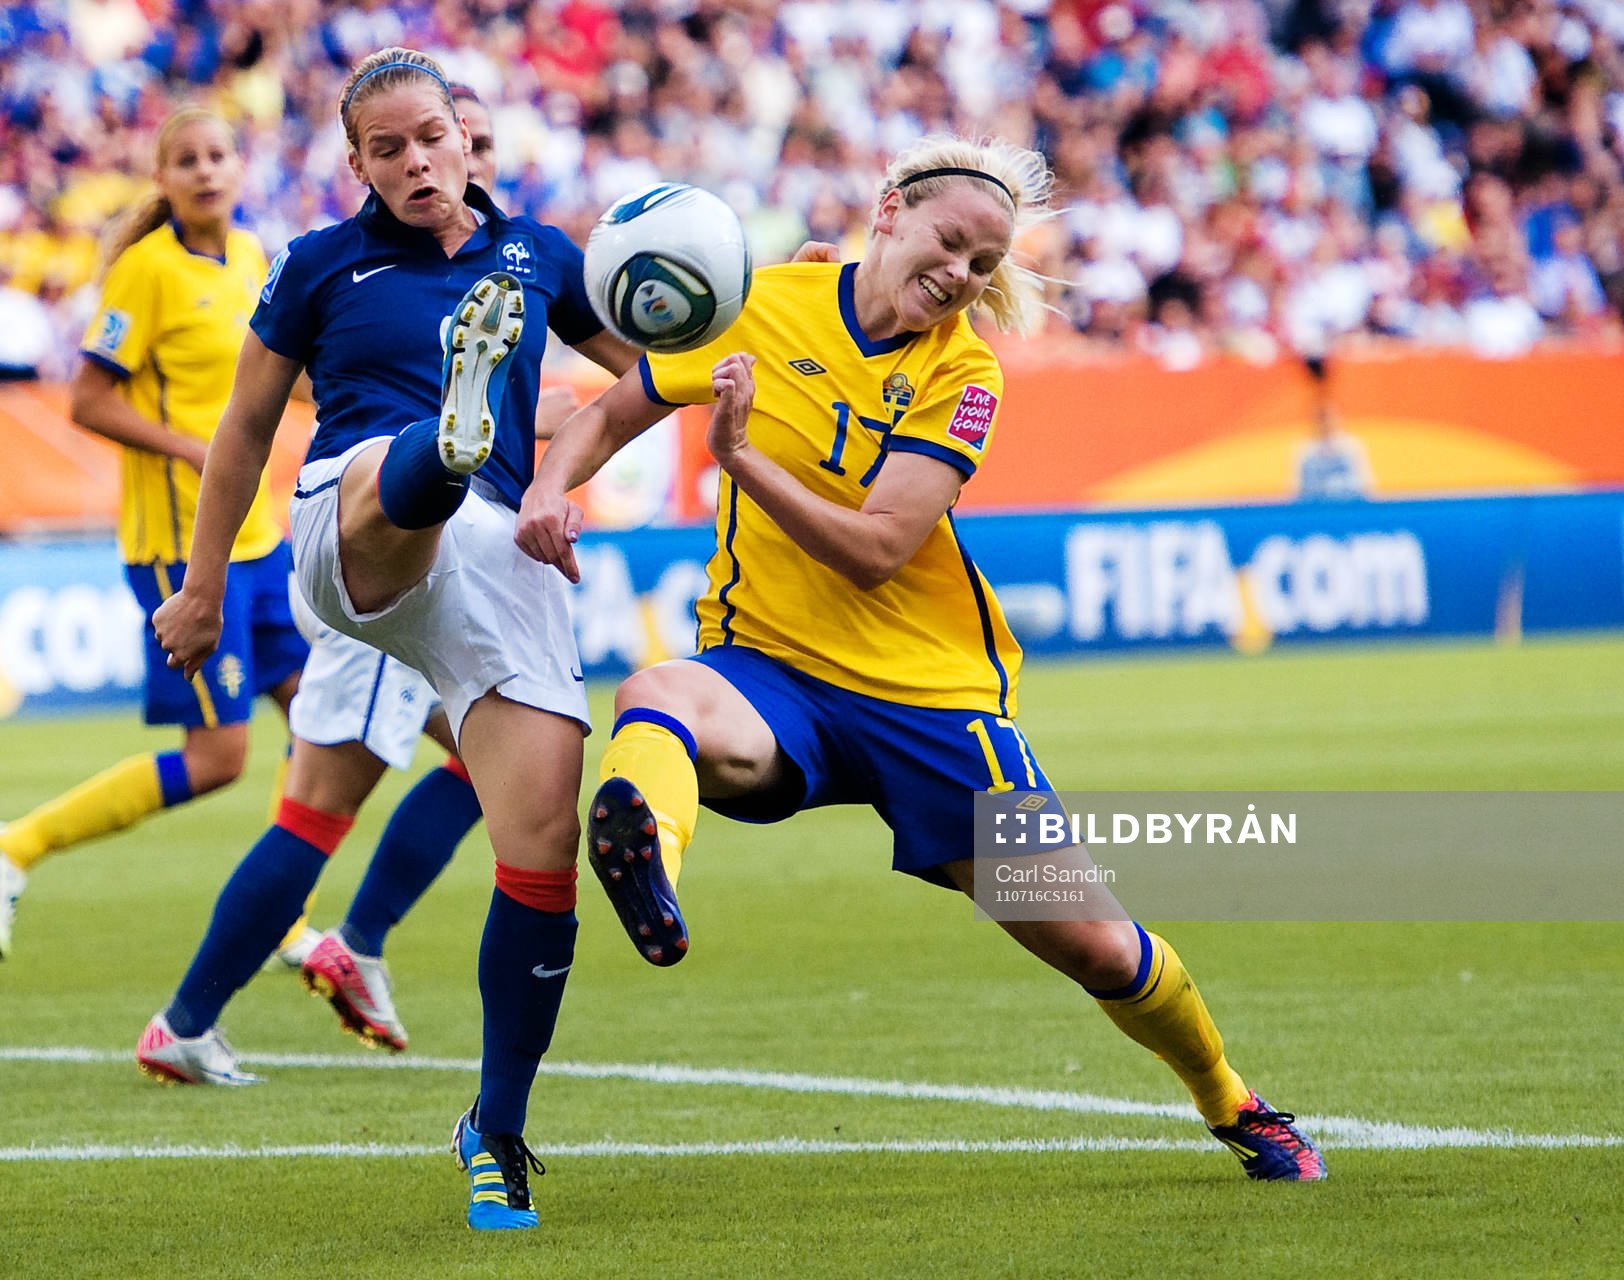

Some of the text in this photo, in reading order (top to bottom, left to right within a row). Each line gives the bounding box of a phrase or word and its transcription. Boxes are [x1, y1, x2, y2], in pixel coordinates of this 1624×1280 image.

[964, 391, 991, 406] LIVE
[959, 404, 991, 421] YOUR
[953, 417, 990, 433] GOALS
[819, 401, 892, 488] 17
[966, 717, 1037, 795] 17
